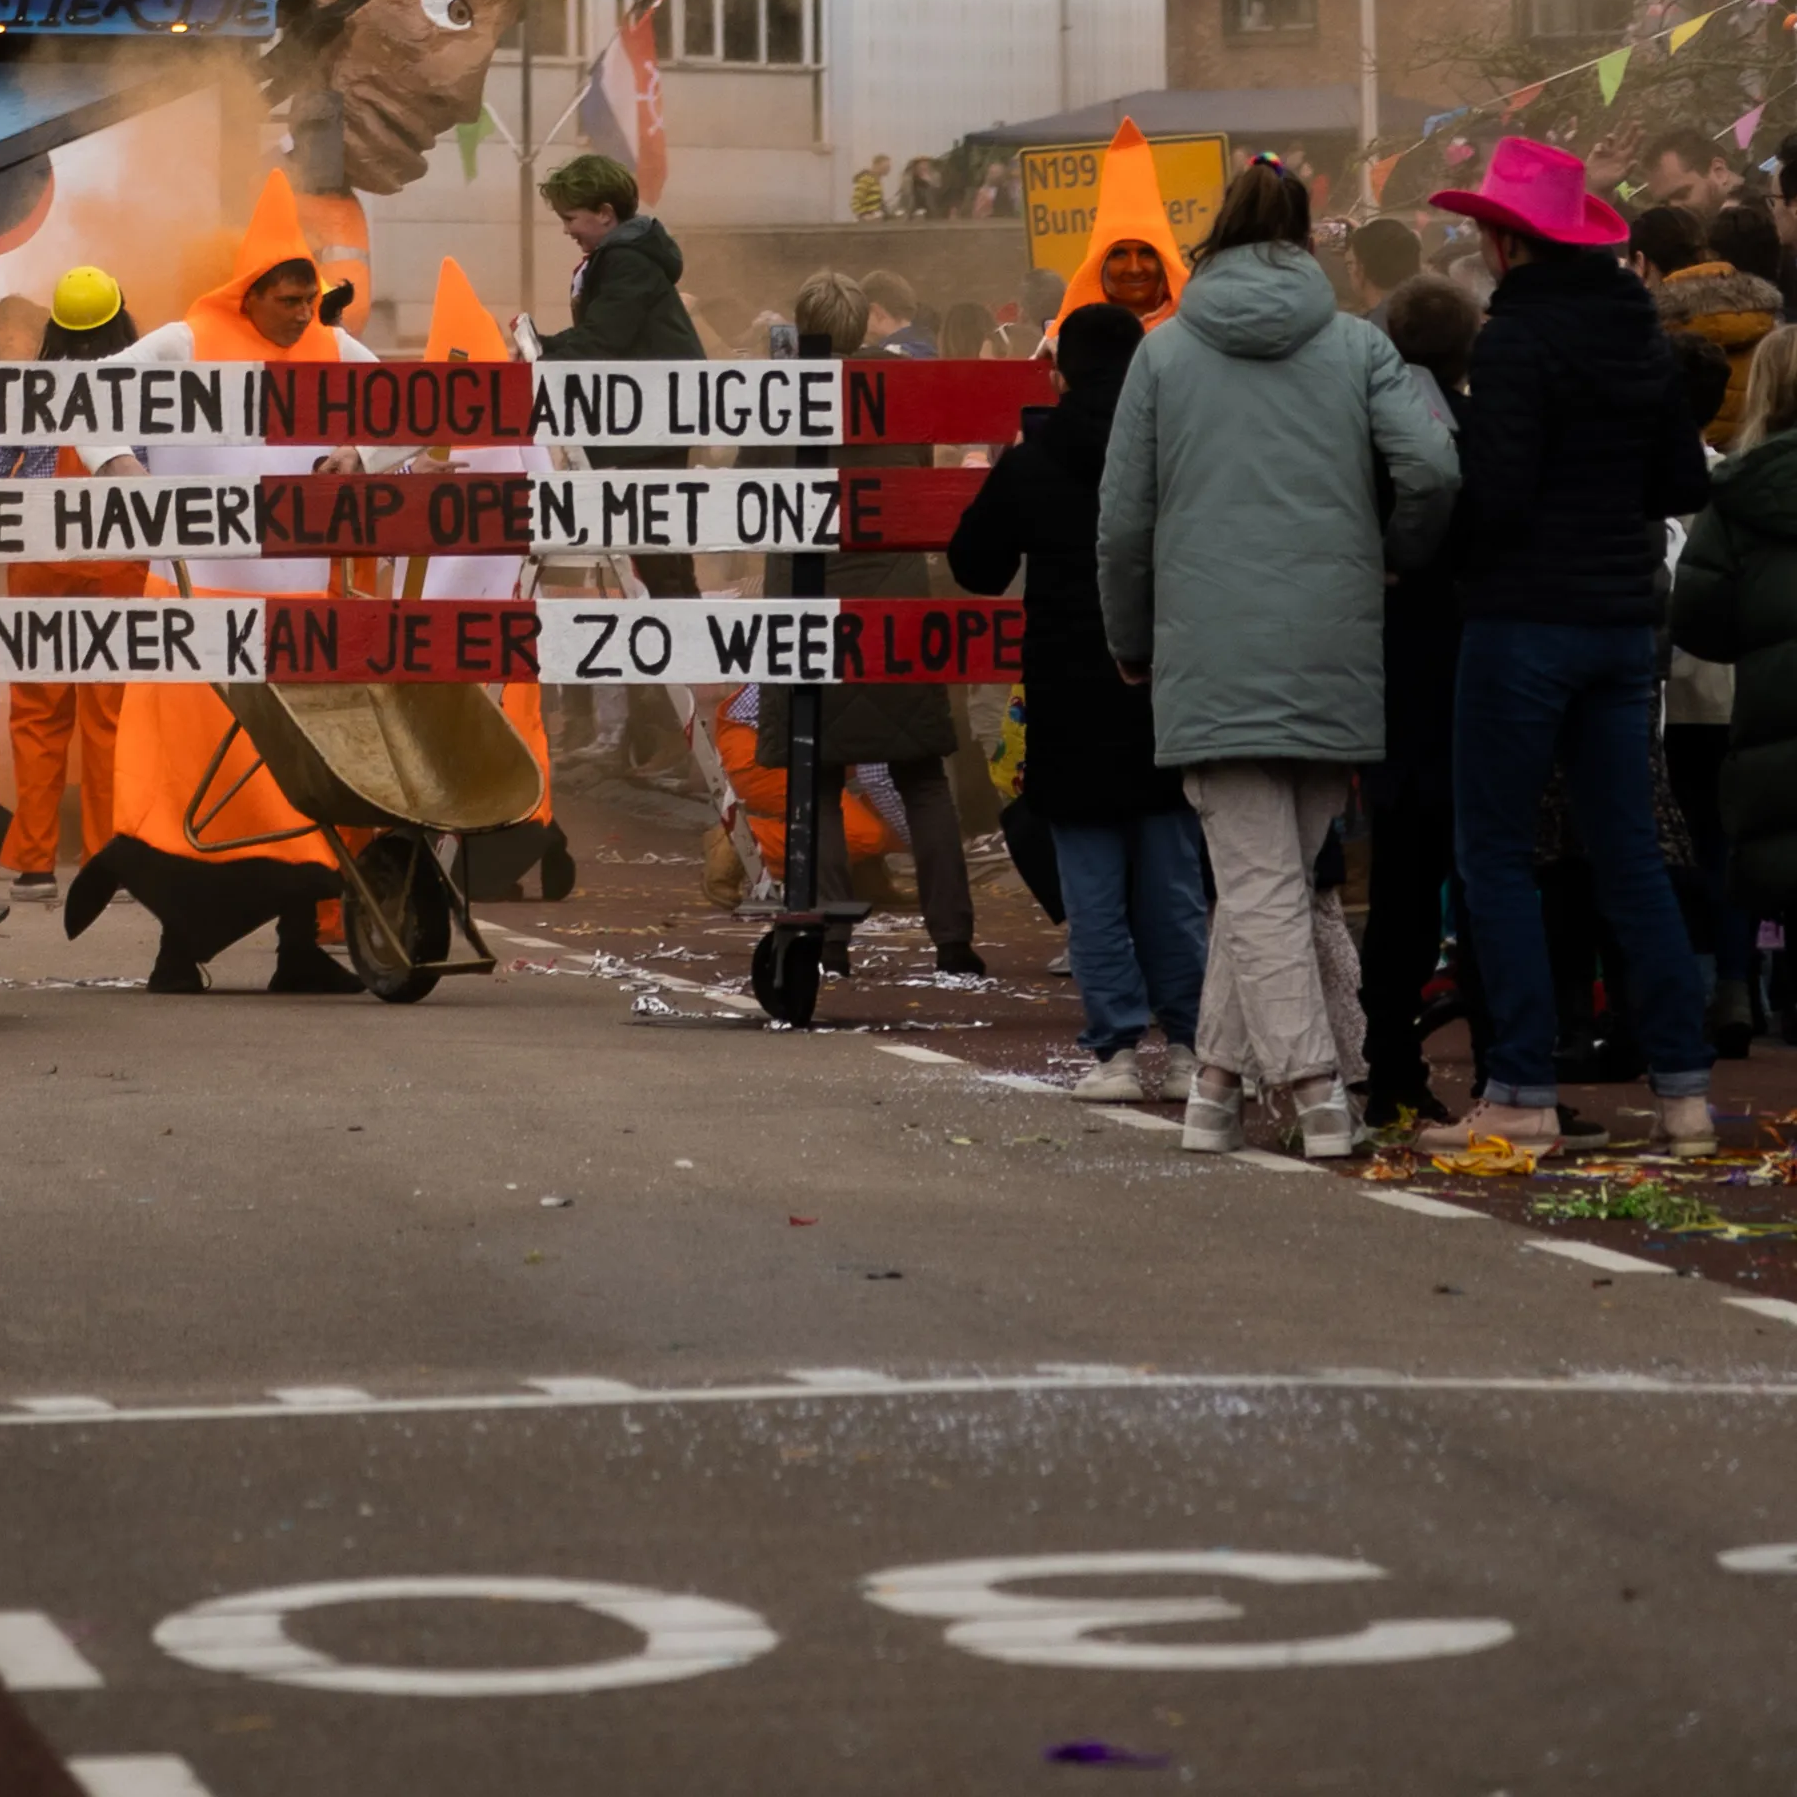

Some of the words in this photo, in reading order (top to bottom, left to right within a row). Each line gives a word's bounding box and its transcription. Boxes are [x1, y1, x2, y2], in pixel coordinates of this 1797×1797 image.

[243, 369, 296, 437] IN
[318, 369, 643, 437] HOOGLAND
[668, 369, 885, 437] LIGGEN
[54, 484, 404, 550] HAVERKLAP
[428, 479, 589, 547] OPEN,
[603, 481, 710, 547] MET
[737, 478, 883, 544] ONZE
[226, 608, 338, 676] KAN
[456, 611, 542, 675] ER
[573, 613, 672, 678] ZO
[706, 612, 864, 679] WEER
[883, 609, 1025, 675] LOPE
